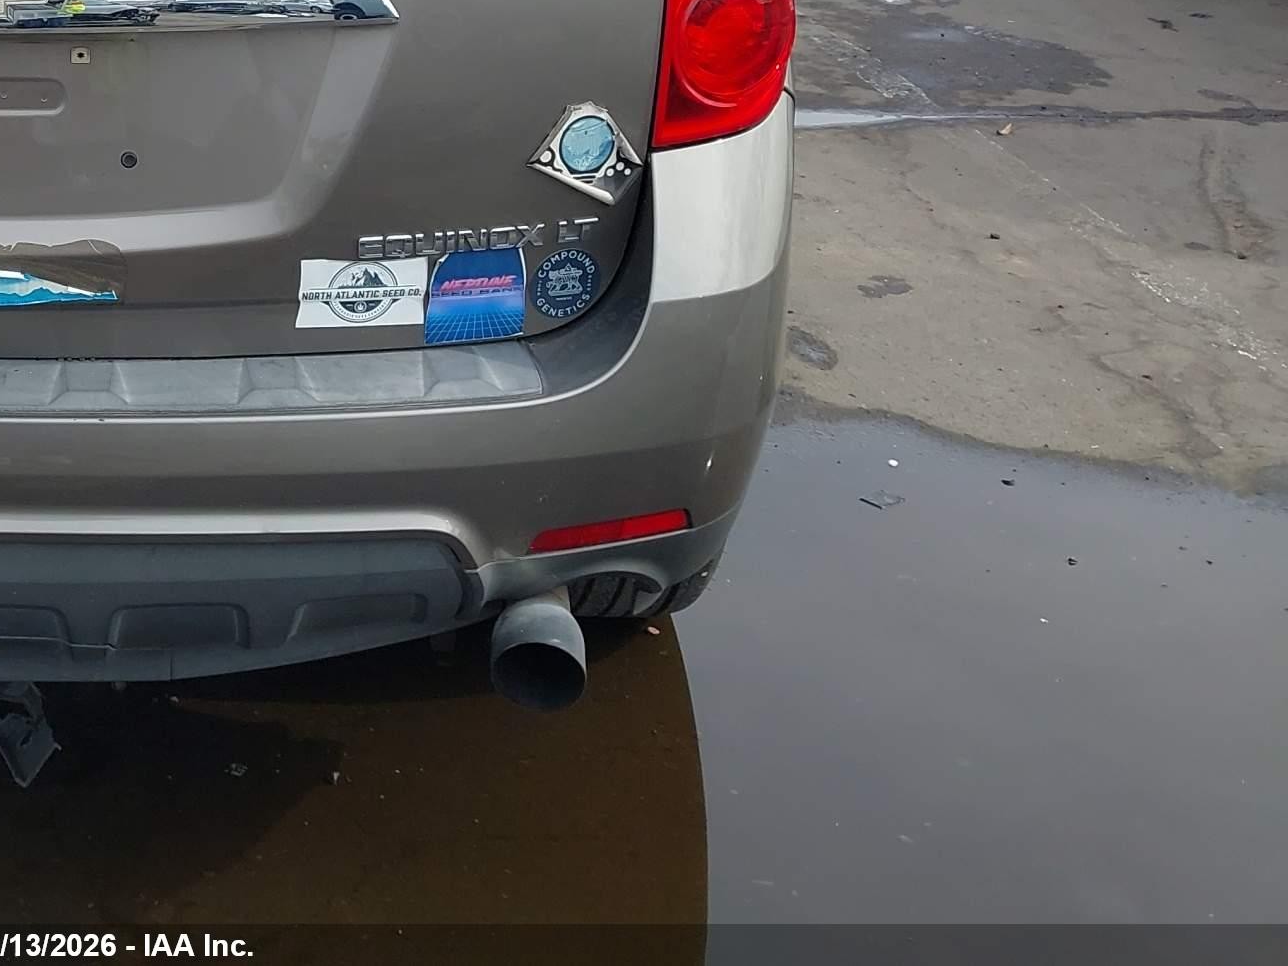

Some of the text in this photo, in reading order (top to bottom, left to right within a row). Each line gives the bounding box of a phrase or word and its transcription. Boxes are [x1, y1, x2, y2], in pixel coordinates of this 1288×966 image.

[357, 216, 600, 260] EQUINOX LT
[537, 249, 596, 279] COMPOUND
[301, 287, 422, 301] NORTH ATLANTIC SEED CO.
[536, 293, 591, 318] GENETICS
